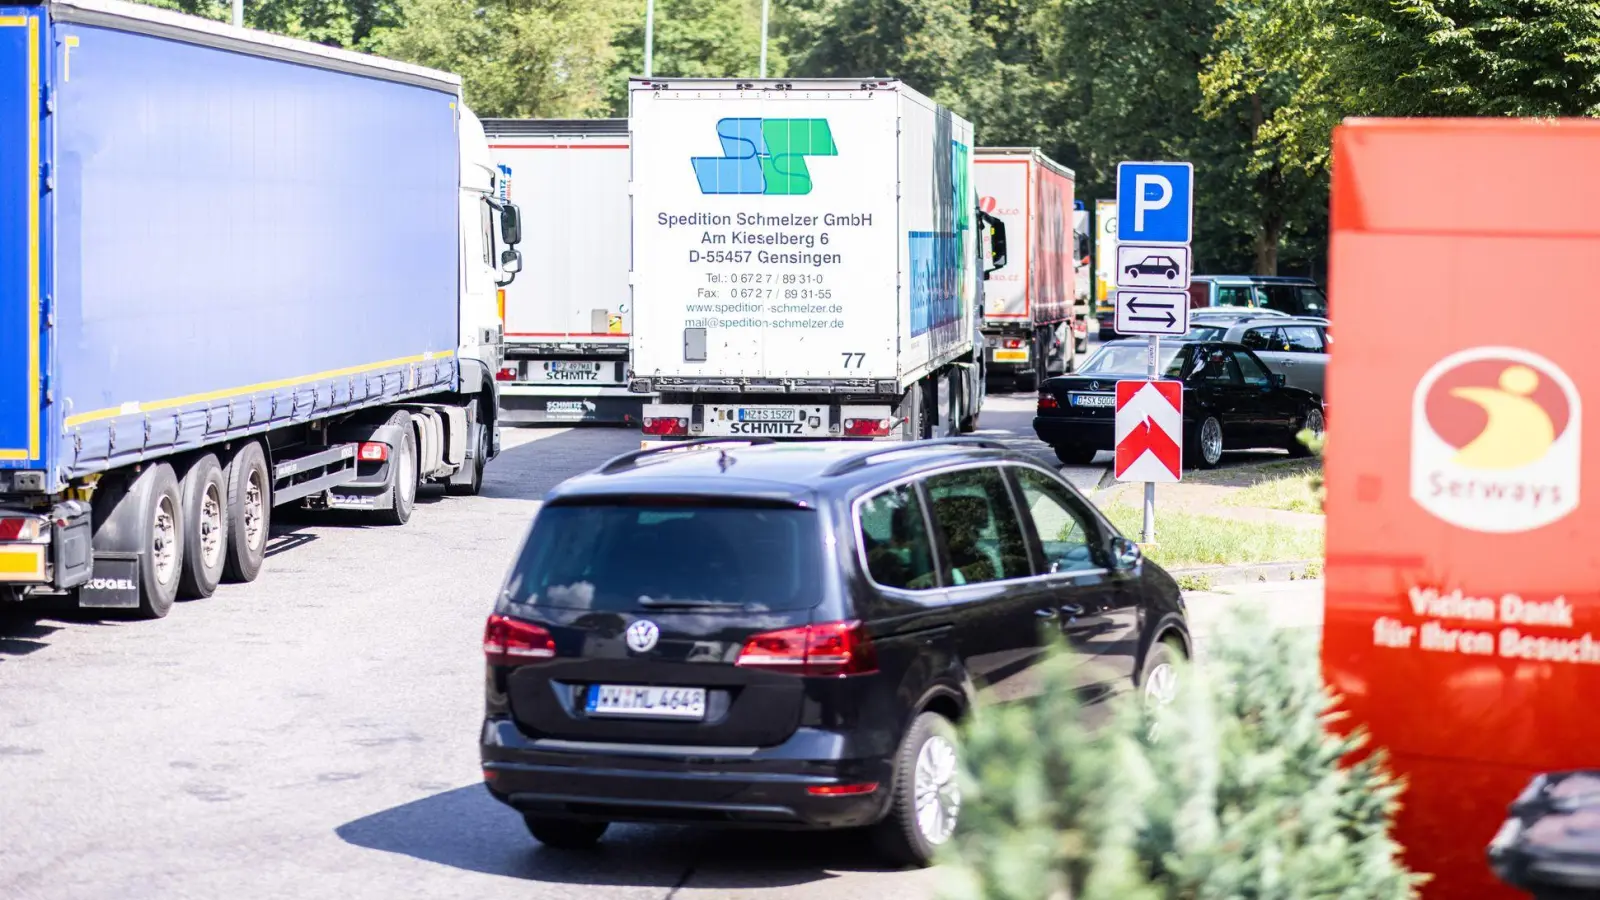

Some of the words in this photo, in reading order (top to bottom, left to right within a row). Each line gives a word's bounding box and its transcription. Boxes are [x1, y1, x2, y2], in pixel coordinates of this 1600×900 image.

[1134, 174, 1173, 232] P
[658, 212, 731, 228] Spedition
[736, 212, 819, 226] Schmelzer
[824, 213, 872, 226] GmbH
[701, 231, 726, 244] Am
[732, 231, 815, 248] Kieselberg
[820, 232, 829, 245] 6
[689, 250, 752, 263] D-55457
[757, 250, 841, 267] Gensingen
[706, 272, 727, 283] Tel.:
[698, 287, 720, 298] Fax:
[842, 352, 866, 368] 77
[546, 370, 598, 380] SCHMITZ
[744, 410, 757, 419] MZ
[771, 411, 793, 420] 1527
[731, 422, 803, 434] SCHMITZ
[1428, 470, 1563, 507] Serways
[1408, 586, 1496, 621] Vielen
[1500, 594, 1573, 628] Dank
[1372, 616, 1416, 649] für
[1420, 620, 1495, 656] Ihren
